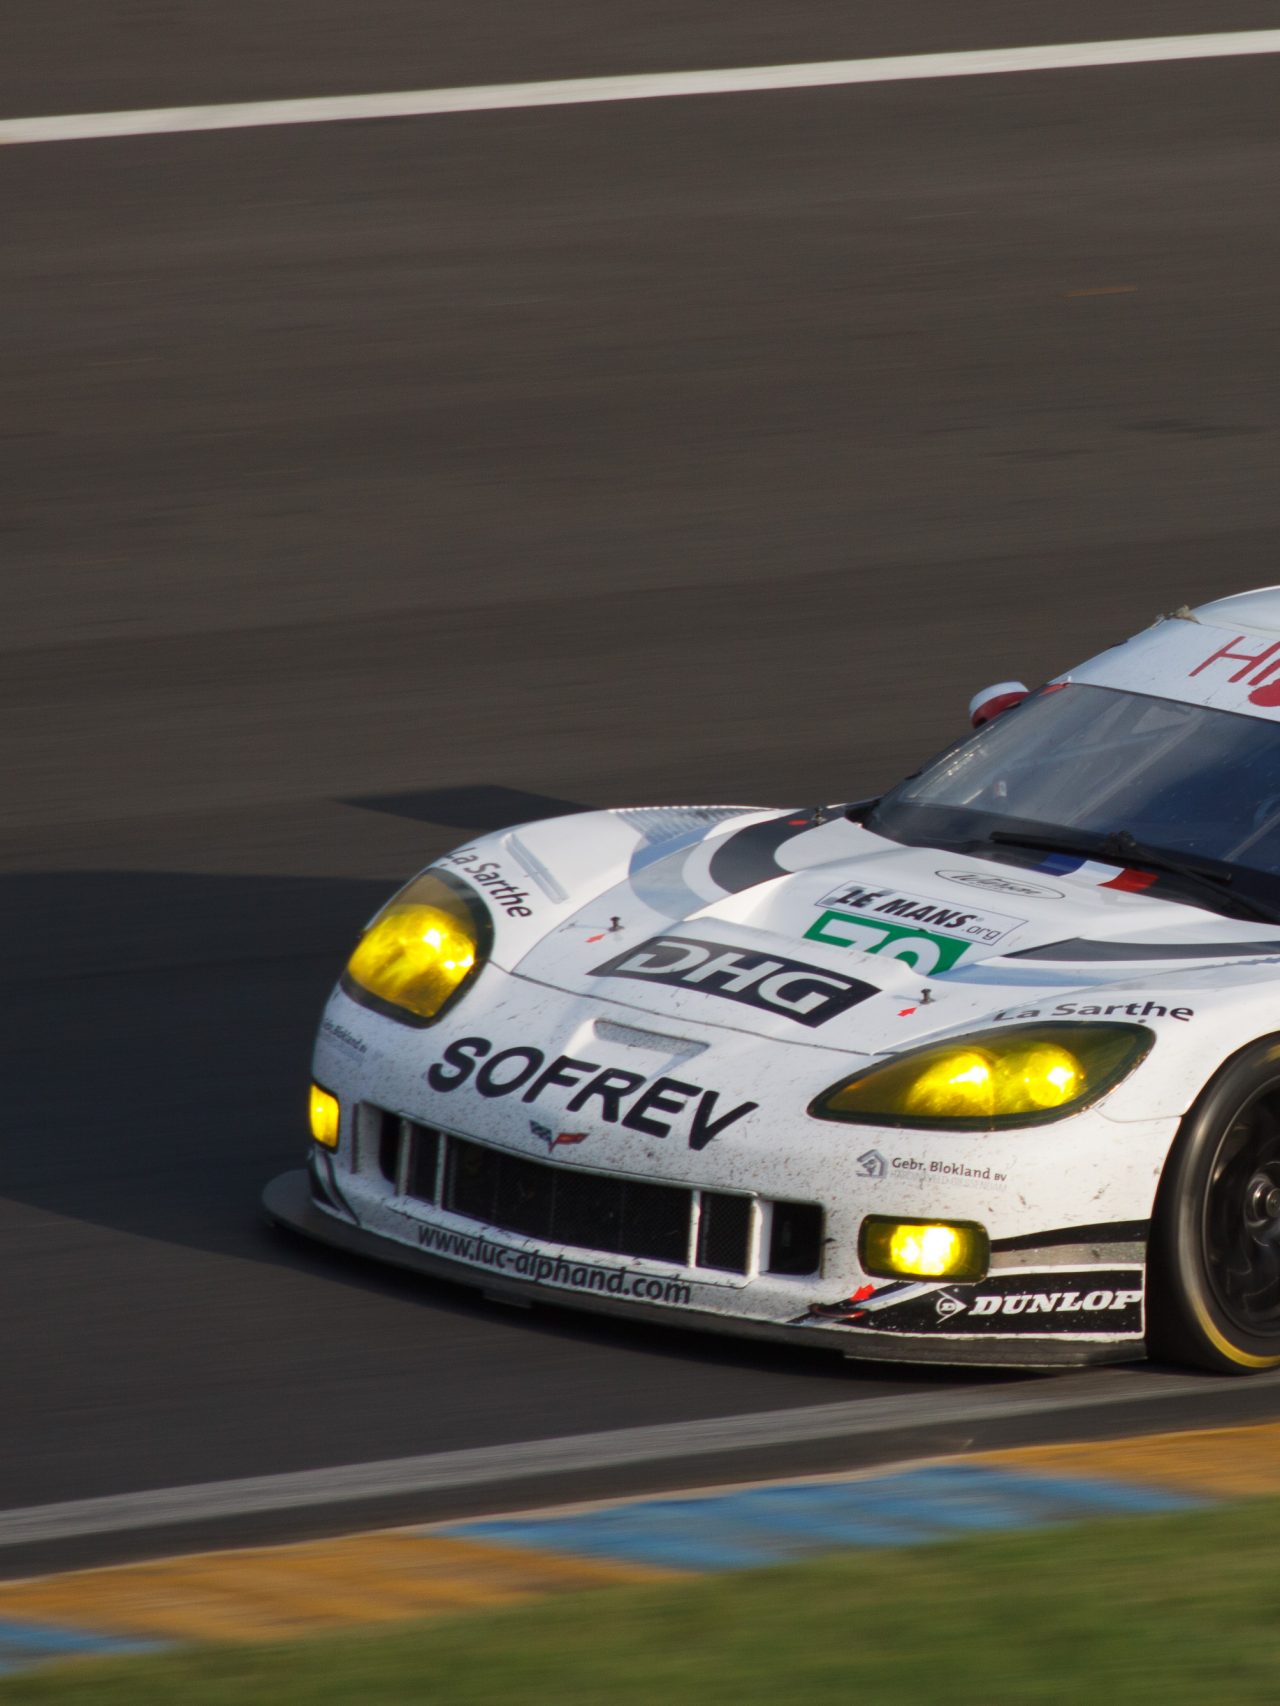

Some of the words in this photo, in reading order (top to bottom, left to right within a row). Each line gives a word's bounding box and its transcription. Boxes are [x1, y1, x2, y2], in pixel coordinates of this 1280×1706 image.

[463, 863, 533, 917] Sarthe
[836, 889, 881, 908] LE
[874, 898, 977, 929] MANS
[616, 941, 852, 1015] DHG
[993, 1009, 1041, 1022] La
[1051, 1001, 1194, 1022] Sarthe
[427, 1036, 759, 1151] SOFREV
[892, 1157, 927, 1171] Gebr.
[930, 1161, 991, 1180] Blokland
[418, 1224, 692, 1304] www.luc-alphand.com
[968, 1290, 1143, 1316] DUNLOP
